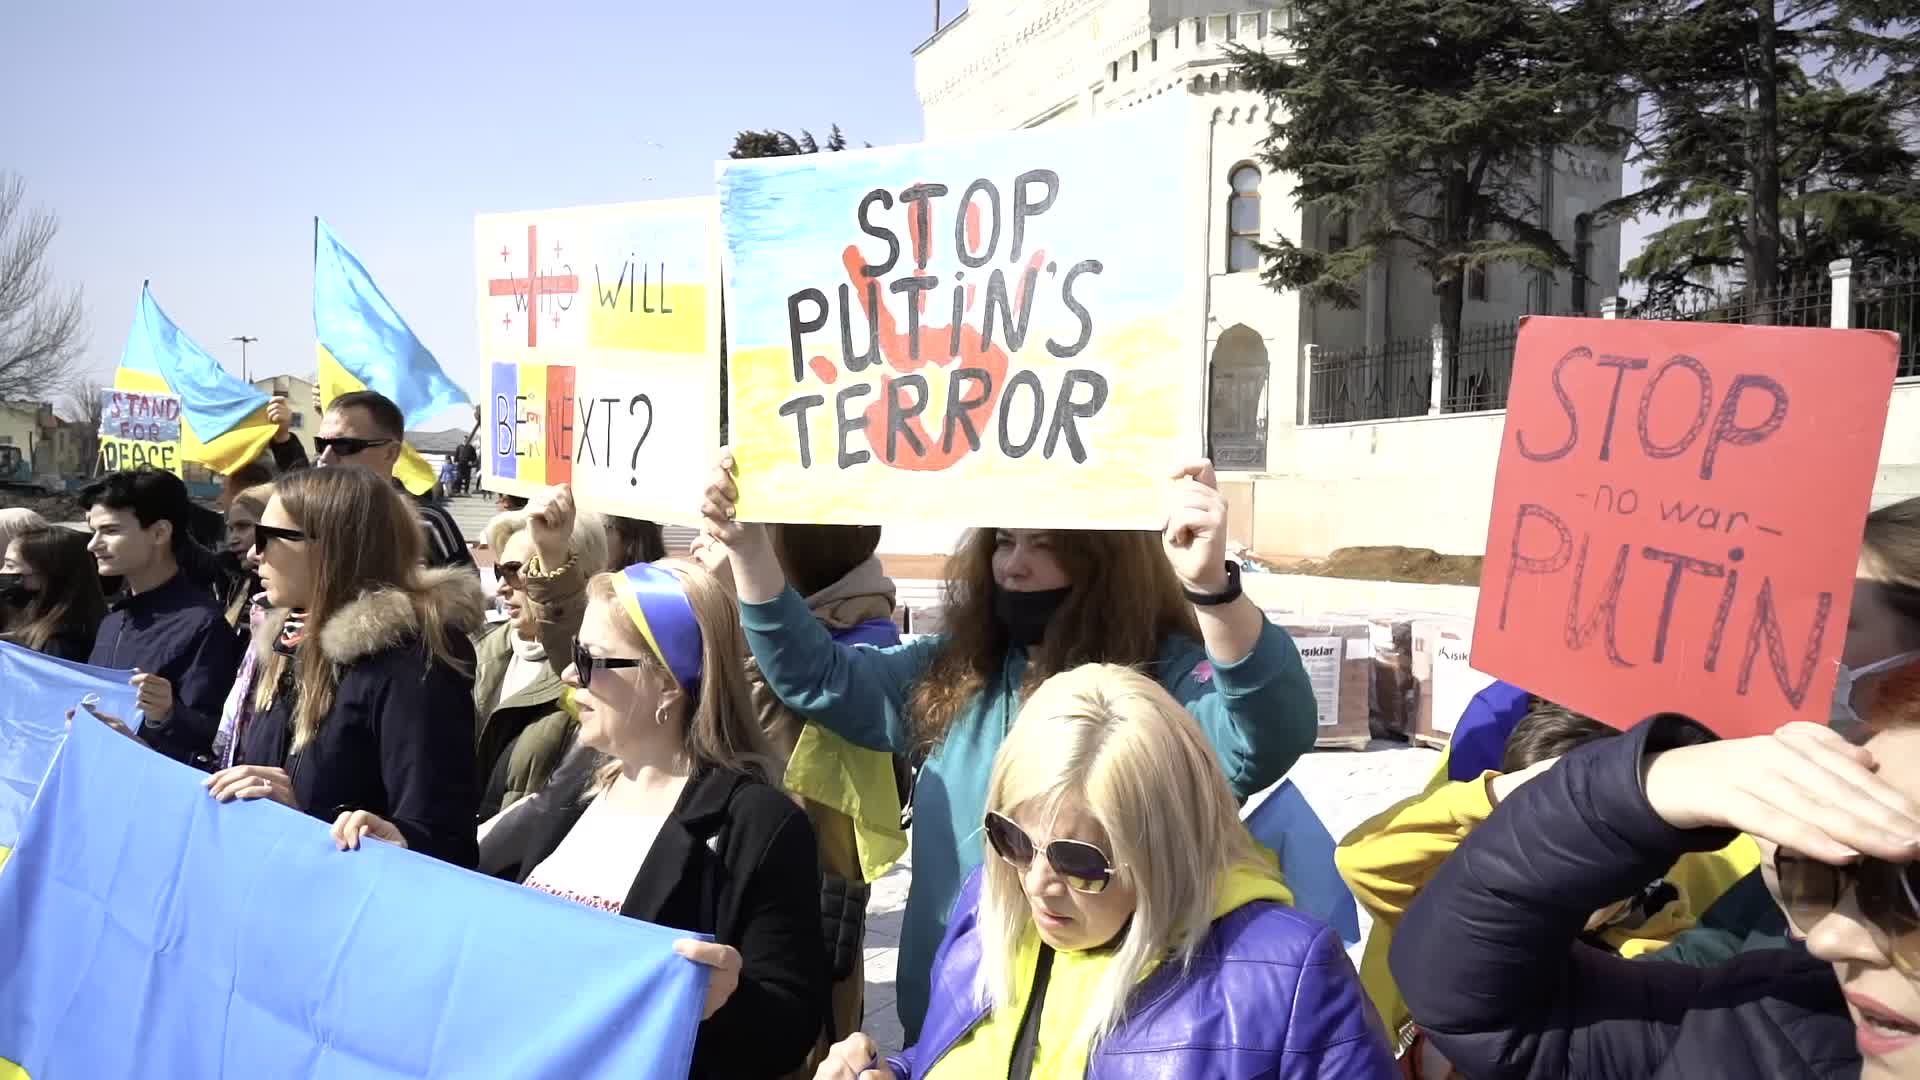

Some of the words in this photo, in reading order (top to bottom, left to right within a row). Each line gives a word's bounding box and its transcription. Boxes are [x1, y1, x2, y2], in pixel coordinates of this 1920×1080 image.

[857, 168, 1059, 277] STOP
[510, 264, 574, 315] WHO
[111, 392, 181, 421] STAND
[120, 421, 161, 441] FOR
[778, 367, 1108, 470] TERROR
[1516, 346, 1789, 480] STOP
